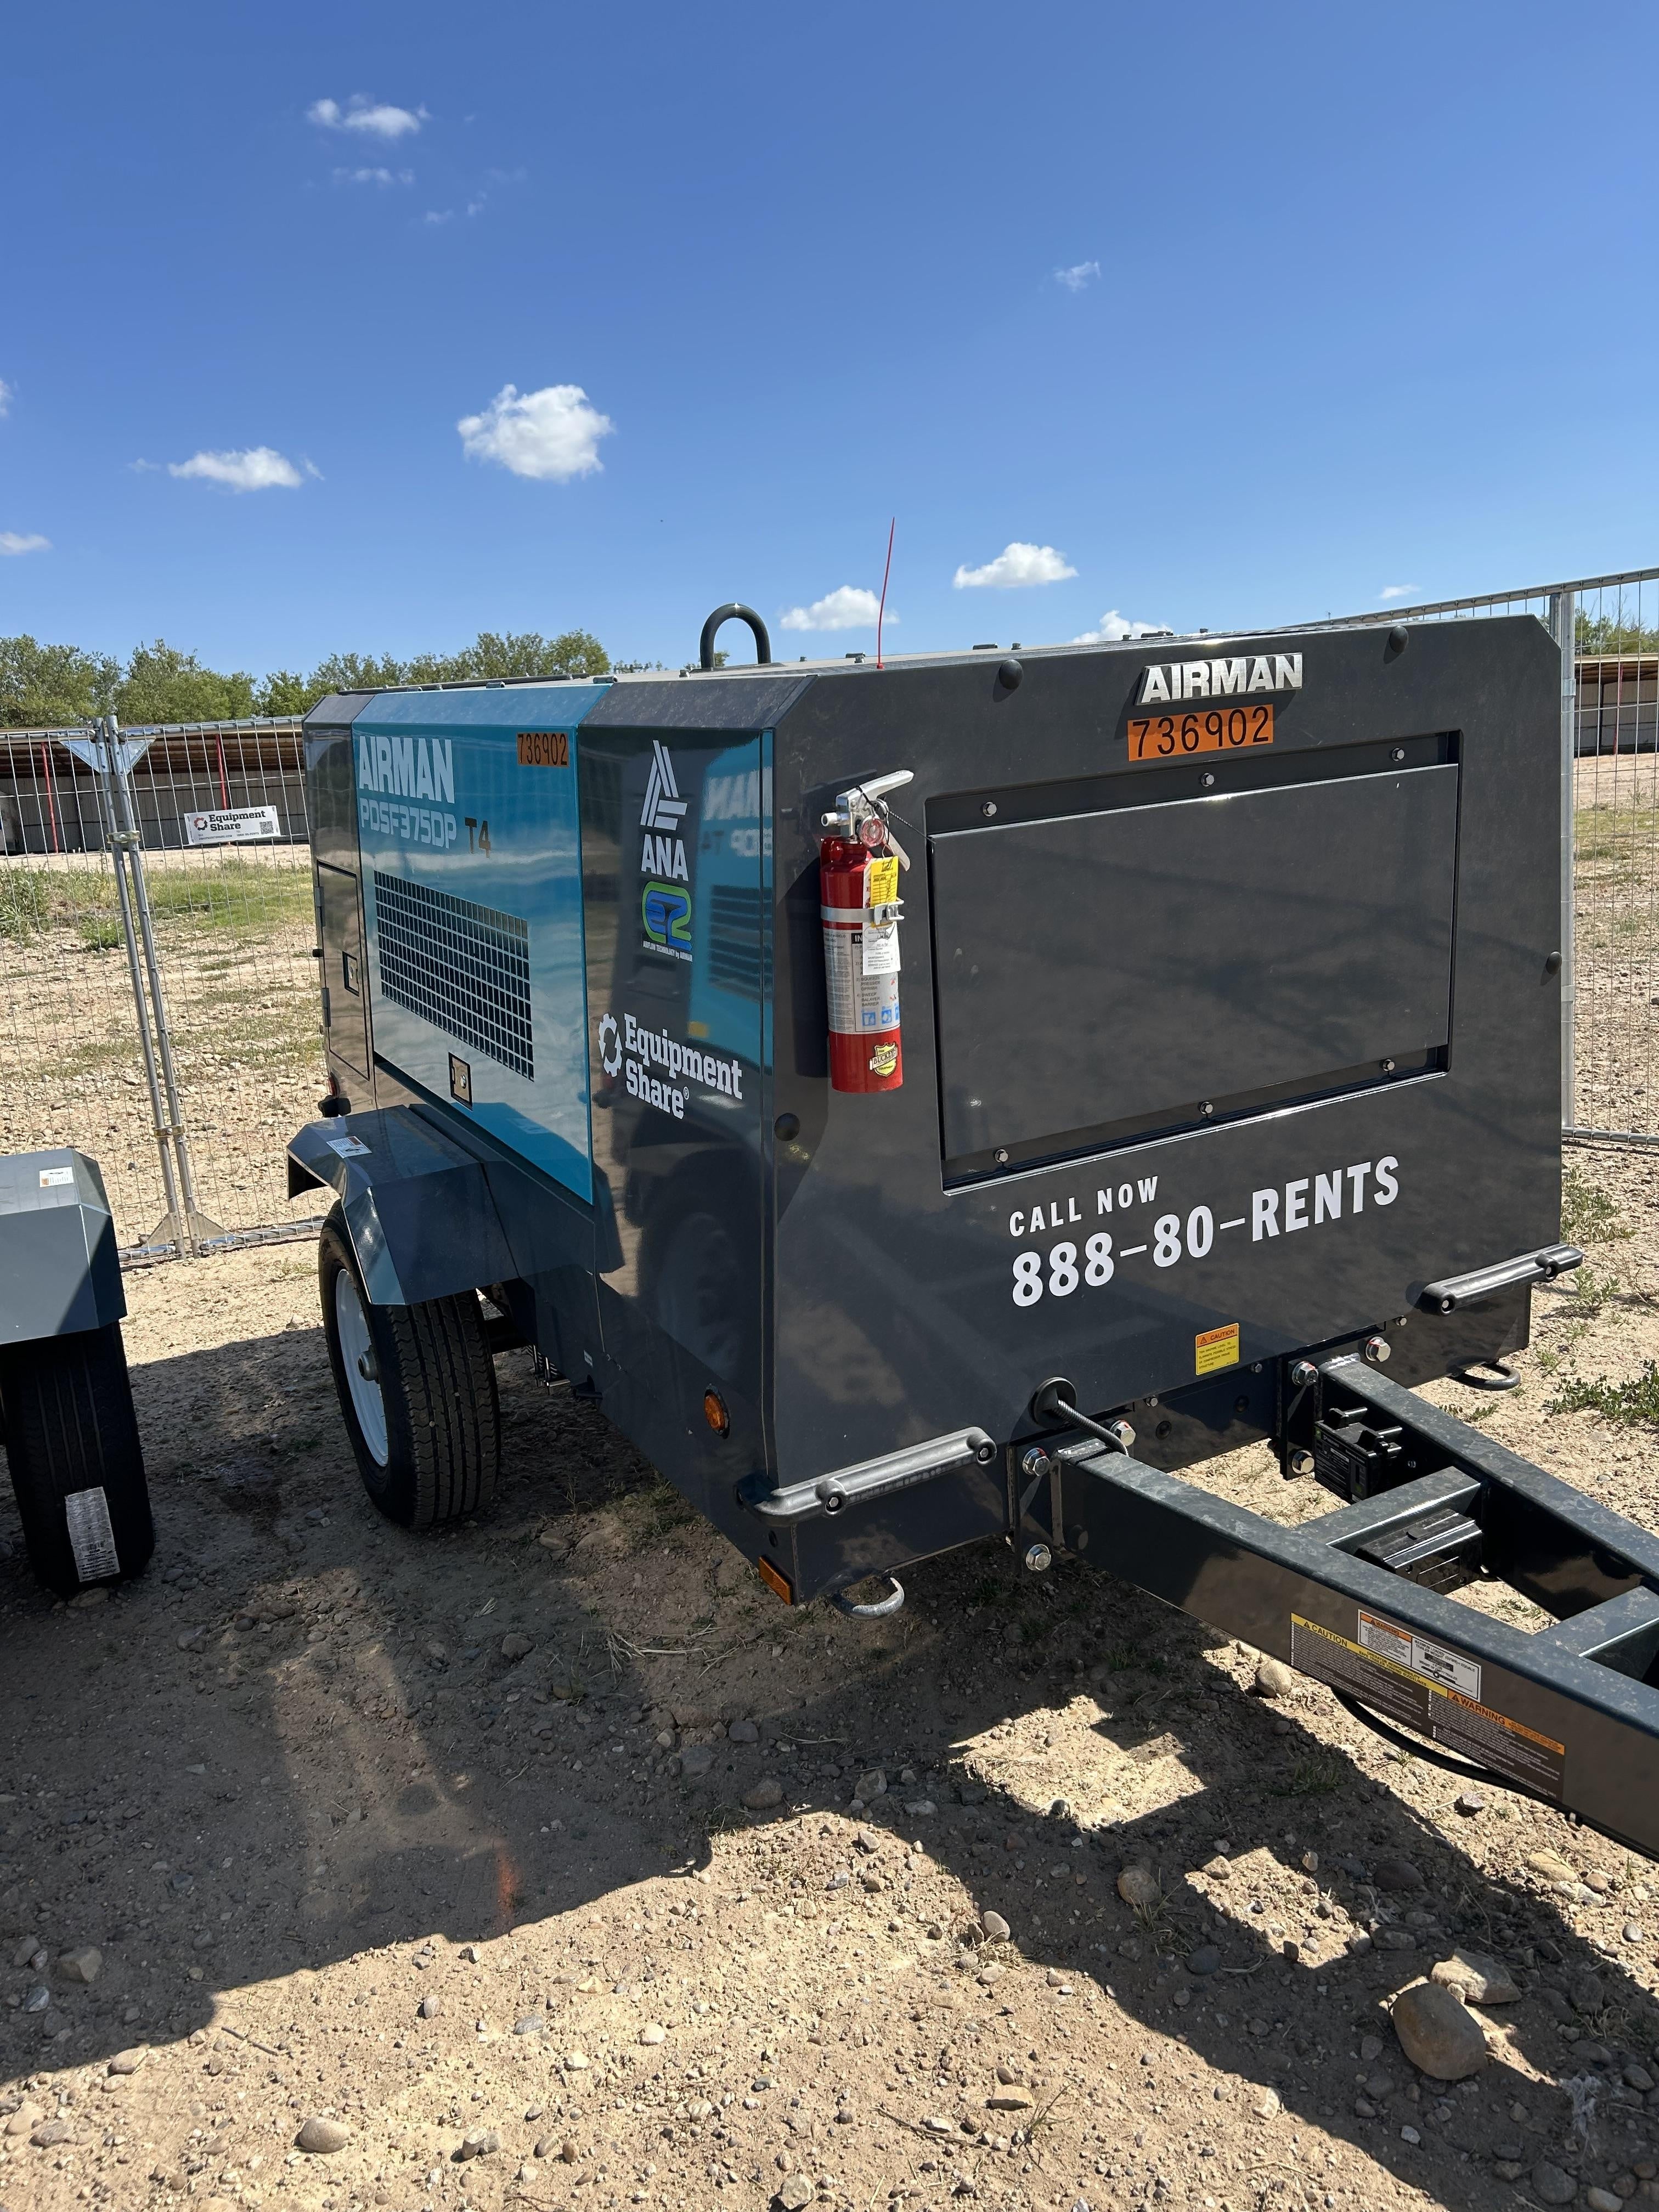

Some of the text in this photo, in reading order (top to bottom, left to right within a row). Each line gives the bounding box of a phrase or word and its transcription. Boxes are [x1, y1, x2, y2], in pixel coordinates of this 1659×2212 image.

[1141, 654, 1302, 703] AIRMAN
[517, 733, 567, 766] 736902
[1132, 706, 1268, 757] 736902
[359, 736, 455, 804] AIRMAN
[208, 810, 266, 822] Equipment
[210, 823, 241, 832] Share
[360, 798, 491, 858] PDSF375DP T4
[641, 833, 689, 882] ANA
[624, 1013, 742, 1100] Equipment
[1009, 1176, 1159, 1237] CALL NOW
[1012, 1155, 1399, 1307] 888-80-RENTS
[1210, 1329, 1234, 1340] CAUTION
[1312, 1624, 1347, 1647] CAUTION
[1460, 1697, 1505, 1725] WARNING
